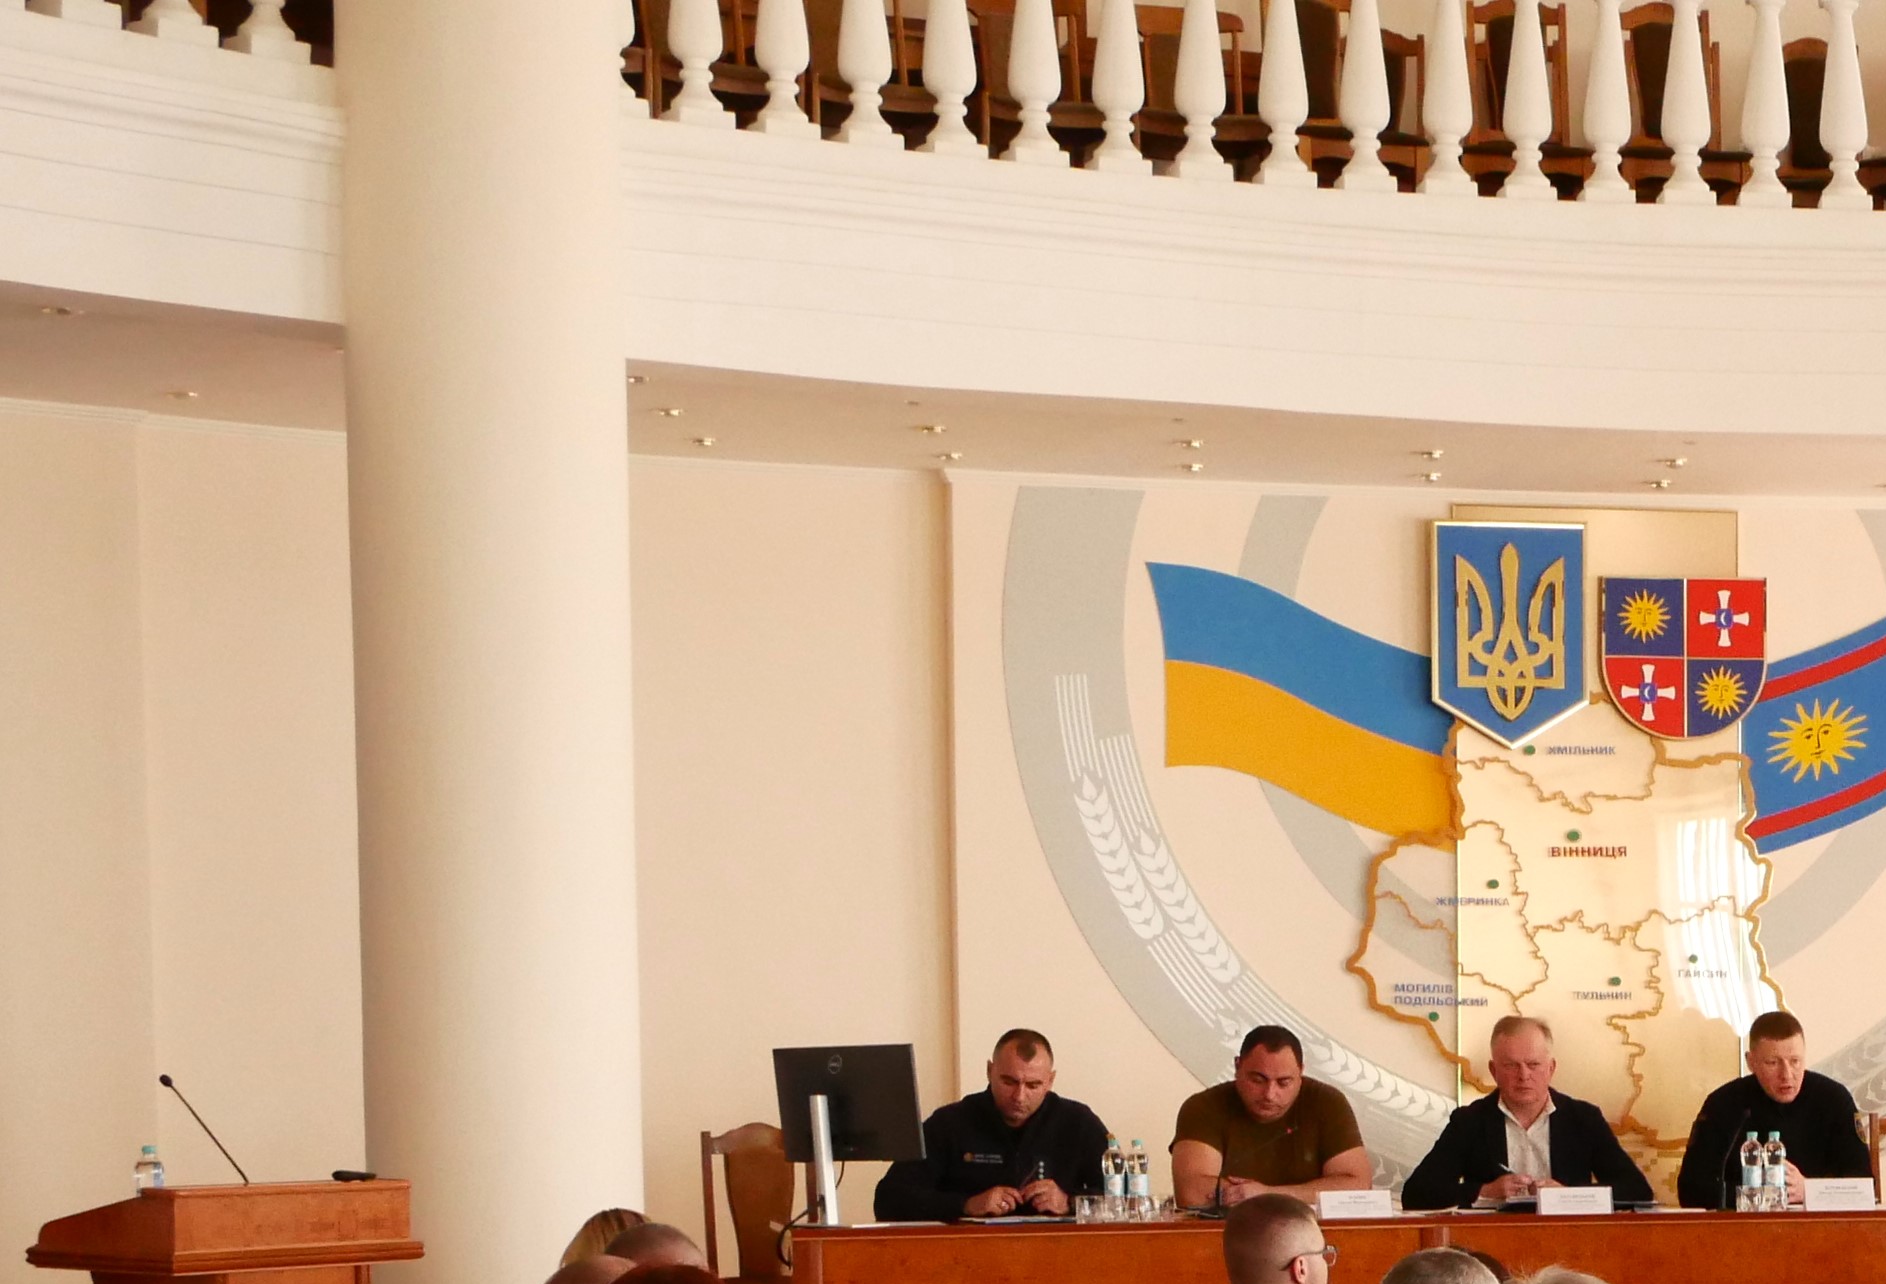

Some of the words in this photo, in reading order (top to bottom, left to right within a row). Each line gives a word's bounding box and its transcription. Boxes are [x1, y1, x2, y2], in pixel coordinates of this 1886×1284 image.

[1547, 745, 1616, 755] ХМІЛЬНИК
[1549, 845, 1627, 859] ВІННИЦЯ
[1678, 969, 1728, 978] ГАЙСИН
[1394, 983, 1454, 994] МОГИЛІВ
[1394, 995, 1489, 1007] ПОДІЛЬСЬКИЙ
